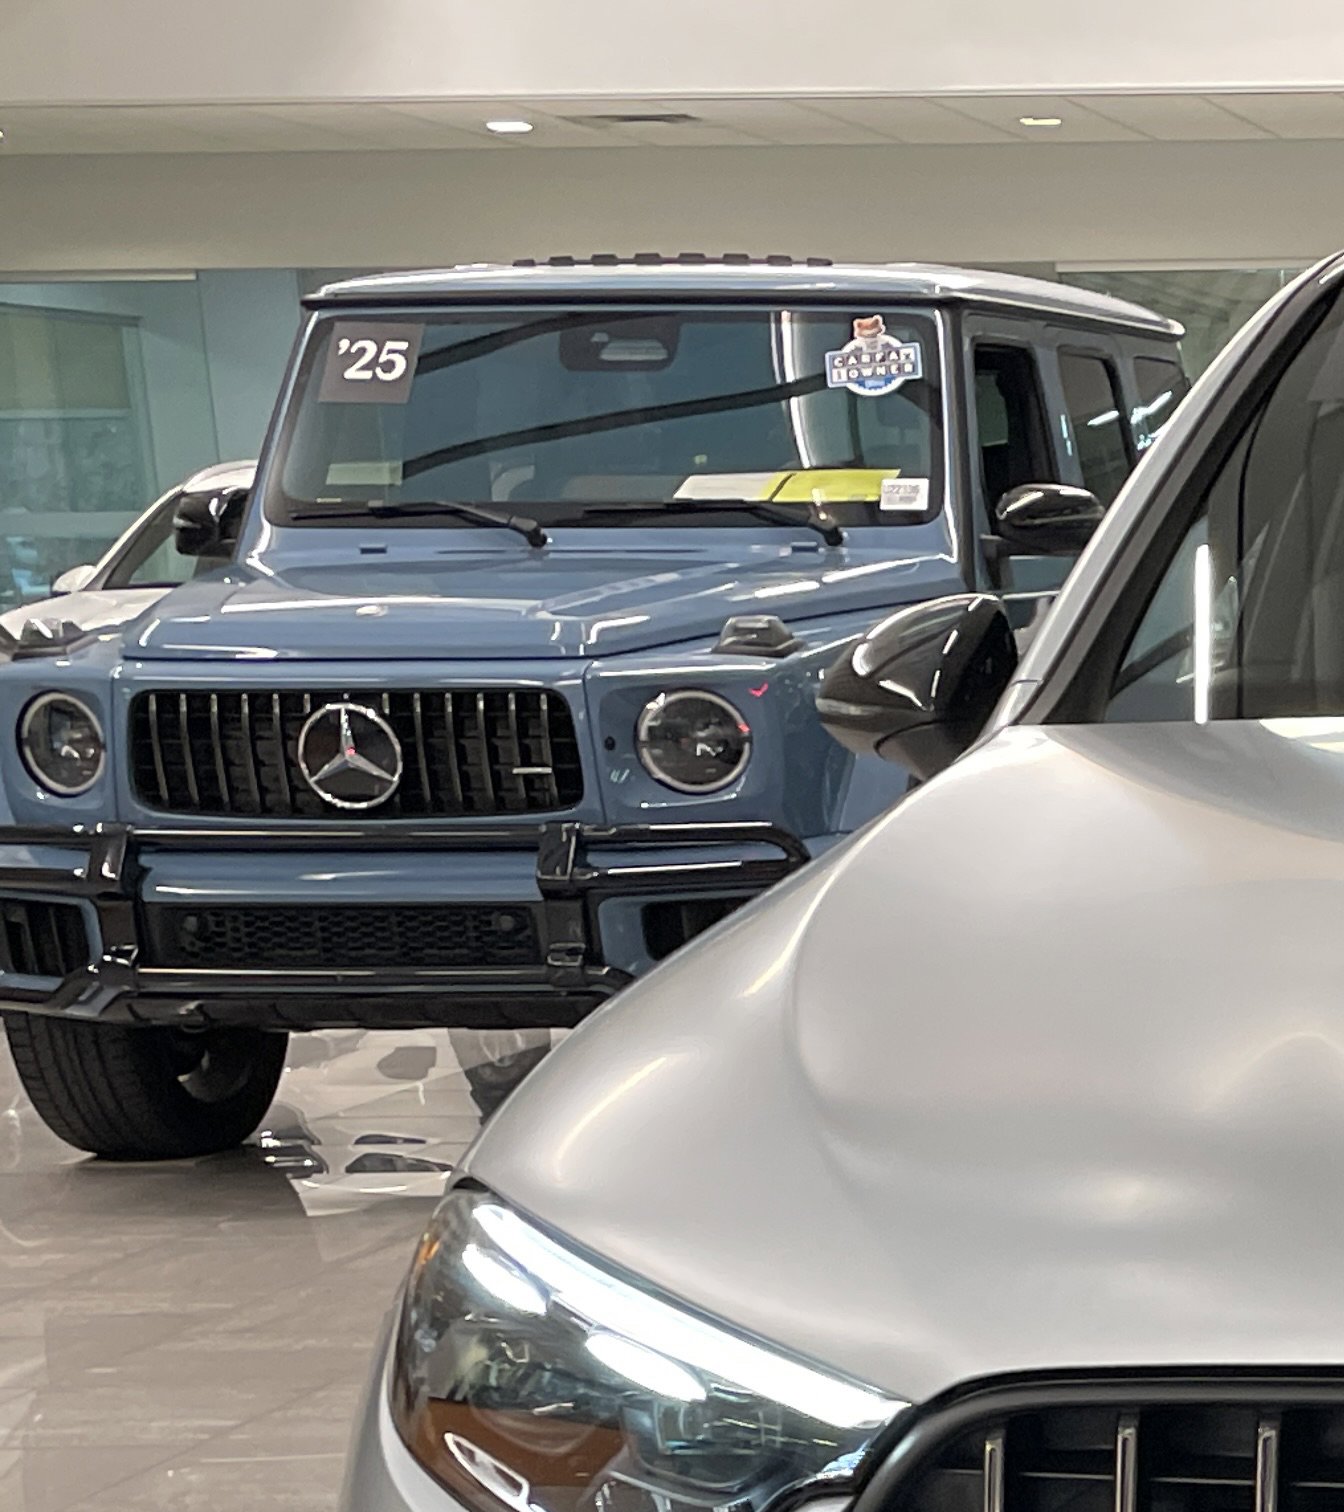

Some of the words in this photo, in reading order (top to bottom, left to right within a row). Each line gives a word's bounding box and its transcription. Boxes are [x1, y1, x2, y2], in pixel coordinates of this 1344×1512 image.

[337, 338, 409, 382] '25
[833, 350, 912, 367] CARFAX
[848, 363, 914, 379] OWNER
